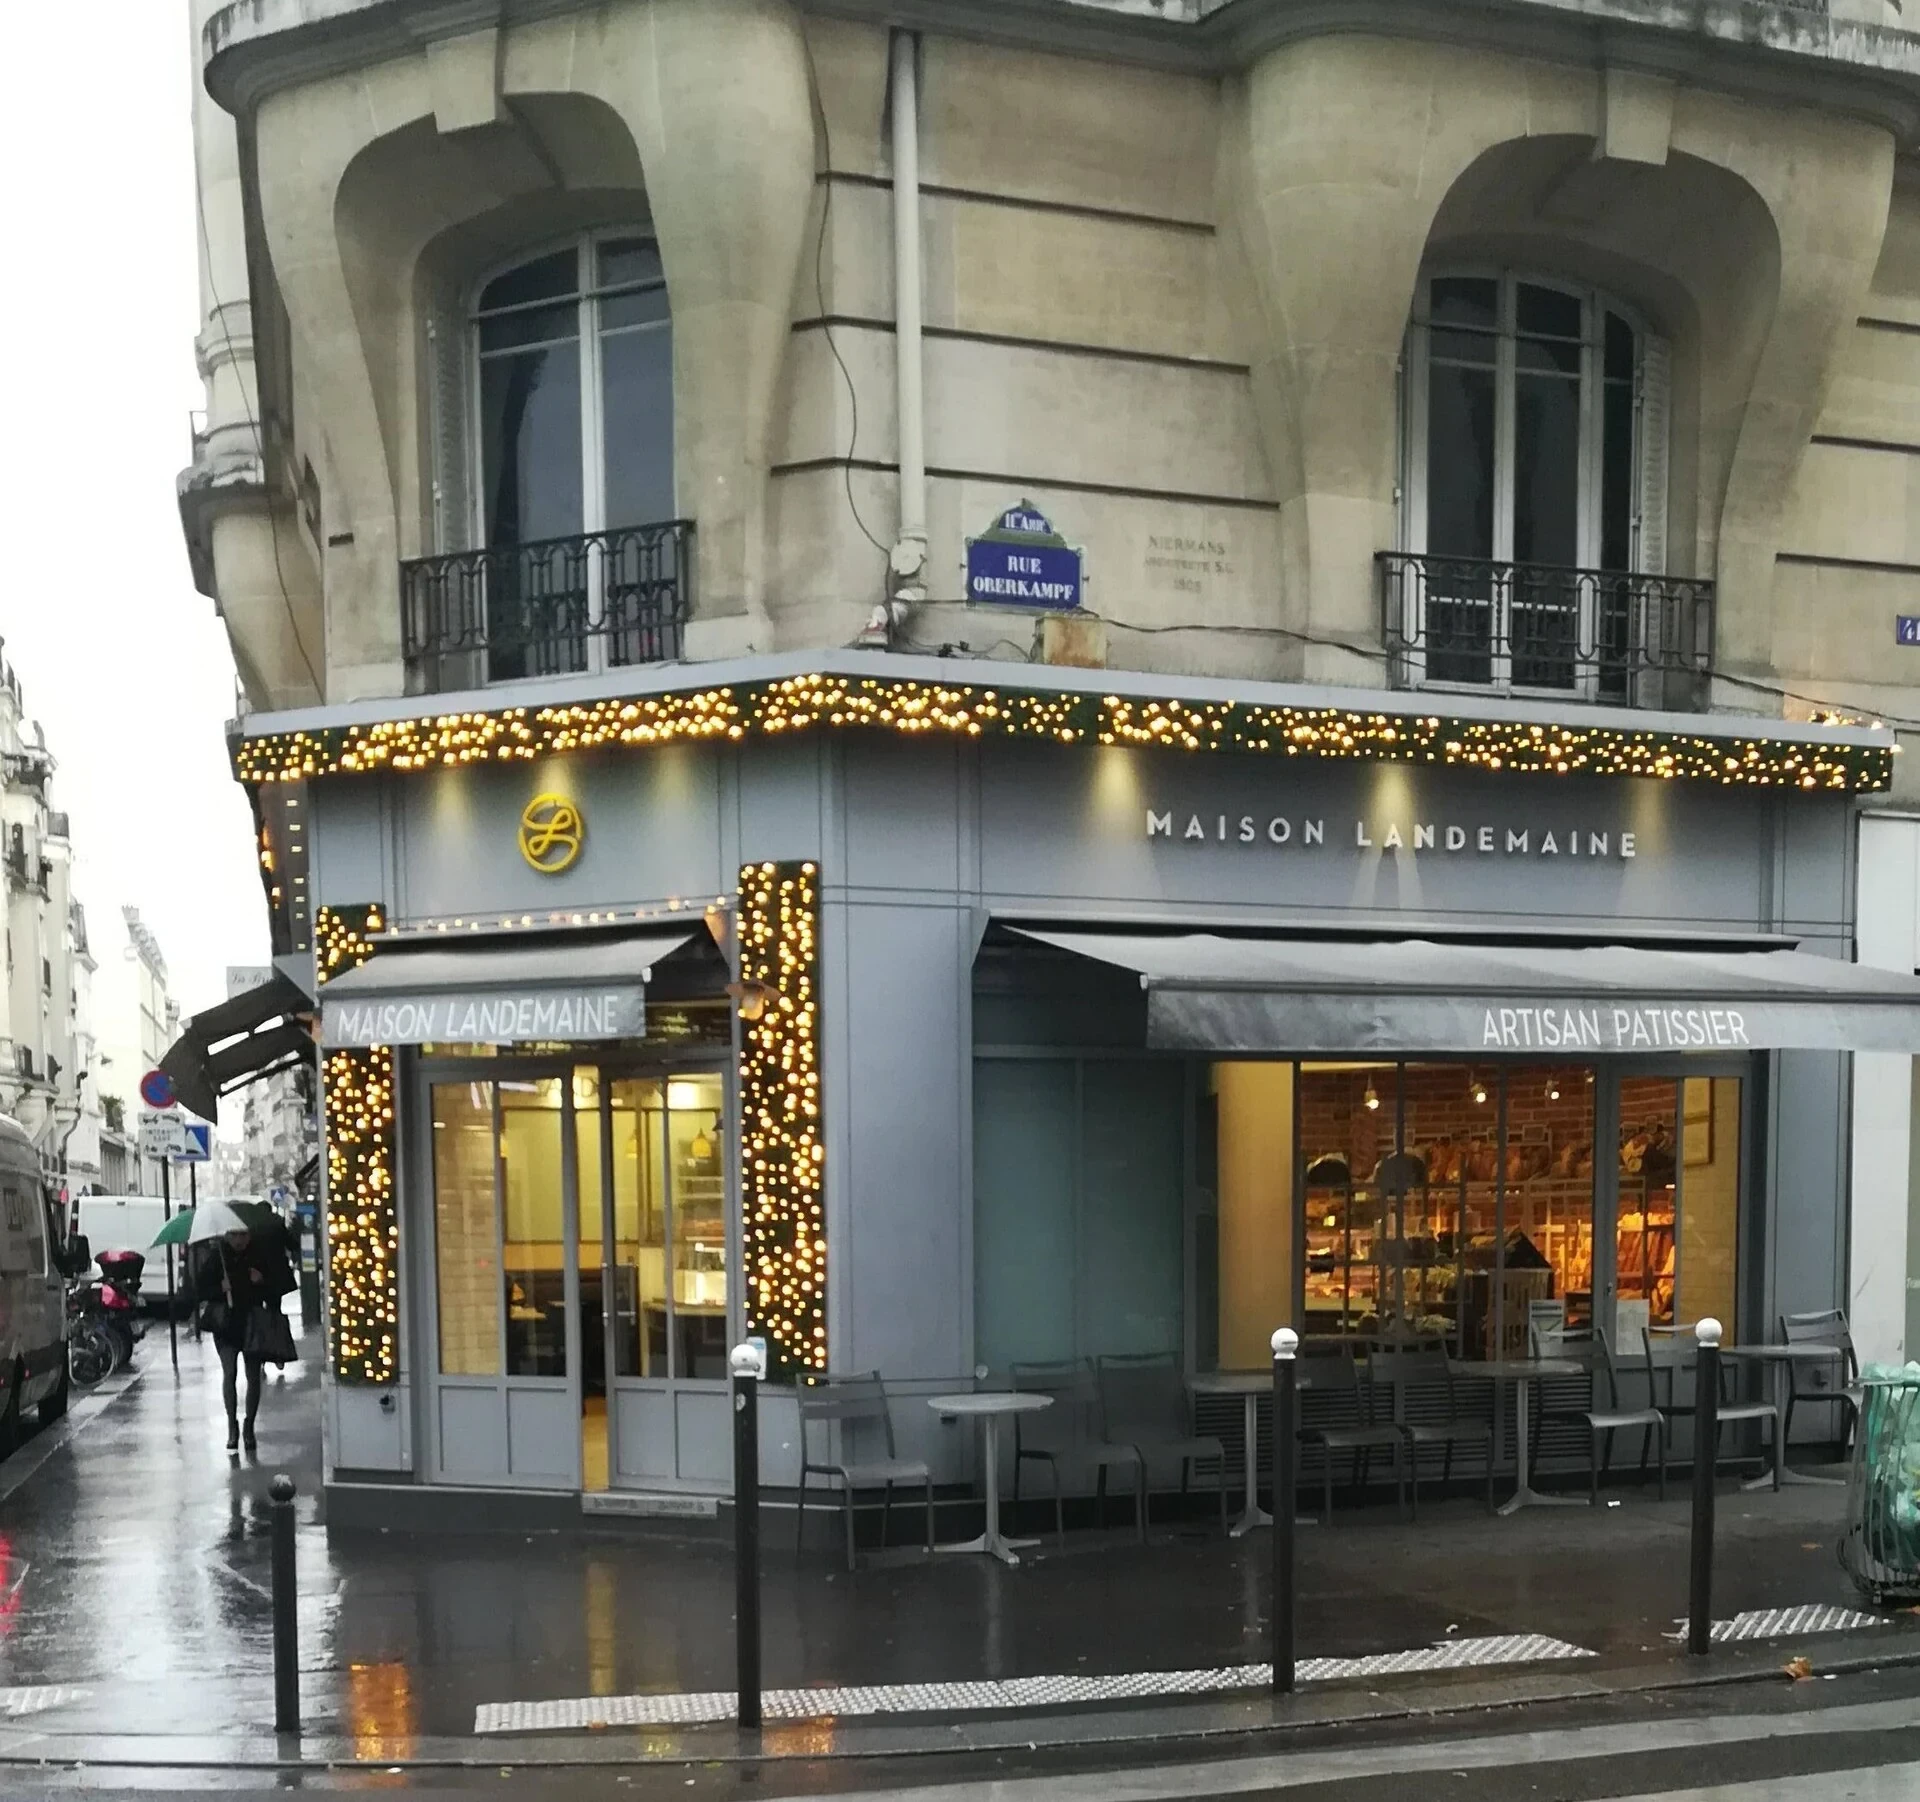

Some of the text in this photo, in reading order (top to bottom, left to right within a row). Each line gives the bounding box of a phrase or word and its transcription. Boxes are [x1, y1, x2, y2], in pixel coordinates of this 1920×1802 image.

[1007, 555, 1042, 575] RUE
[973, 575, 1075, 600] OBERKAMPF
[1146, 809, 1638, 858] MAISON LANDEMAINE
[337, 995, 620, 1043] MAISON LANDEMAINE
[1482, 1008, 1750, 1047] ARTISAN PATISSIER
